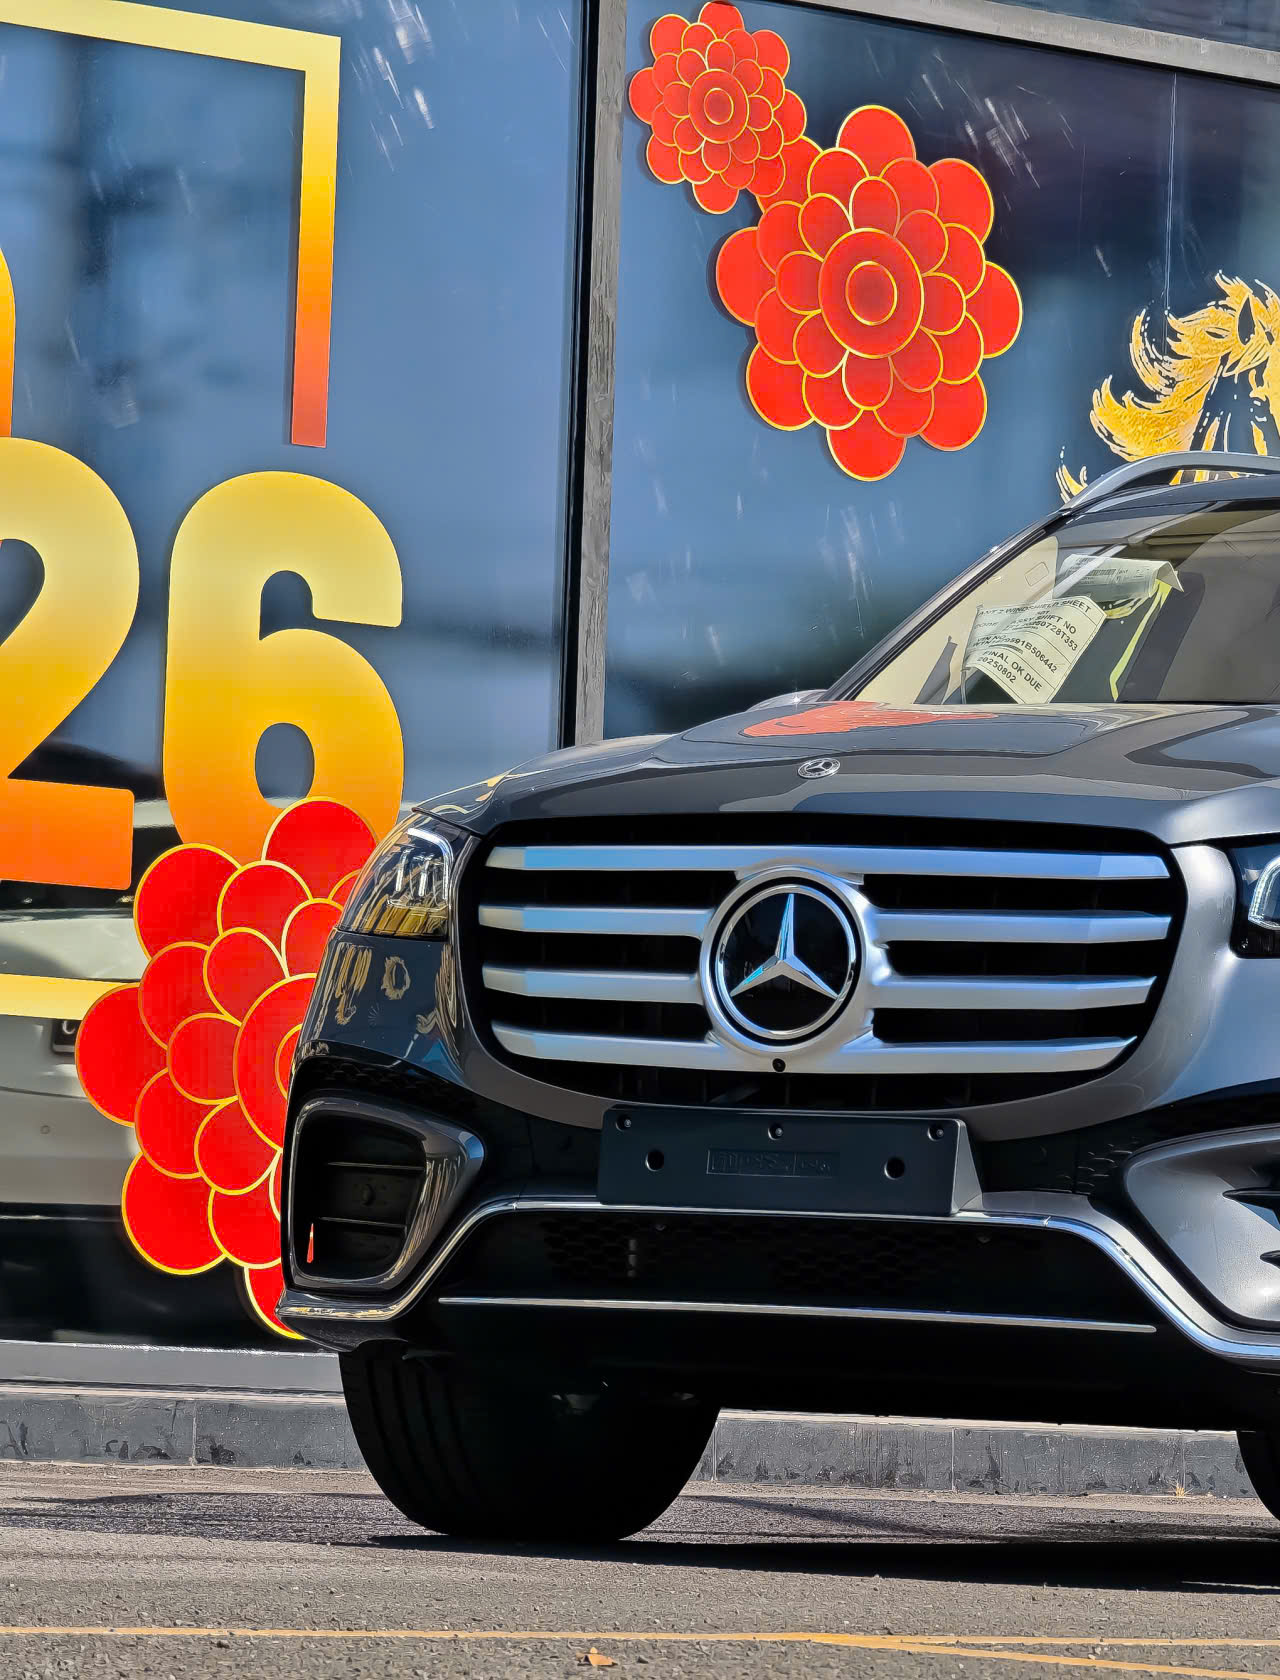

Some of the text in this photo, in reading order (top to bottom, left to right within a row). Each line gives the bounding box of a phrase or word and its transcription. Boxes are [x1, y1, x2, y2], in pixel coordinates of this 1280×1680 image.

[1061, 599, 1091, 613] SHEET
[1035, 614, 1063, 623] SHIFT
[1063, 620, 1077, 634] NO
[977, 656, 1017, 684] 20250802
[982, 650, 1043, 692] FINAL OK DUE
